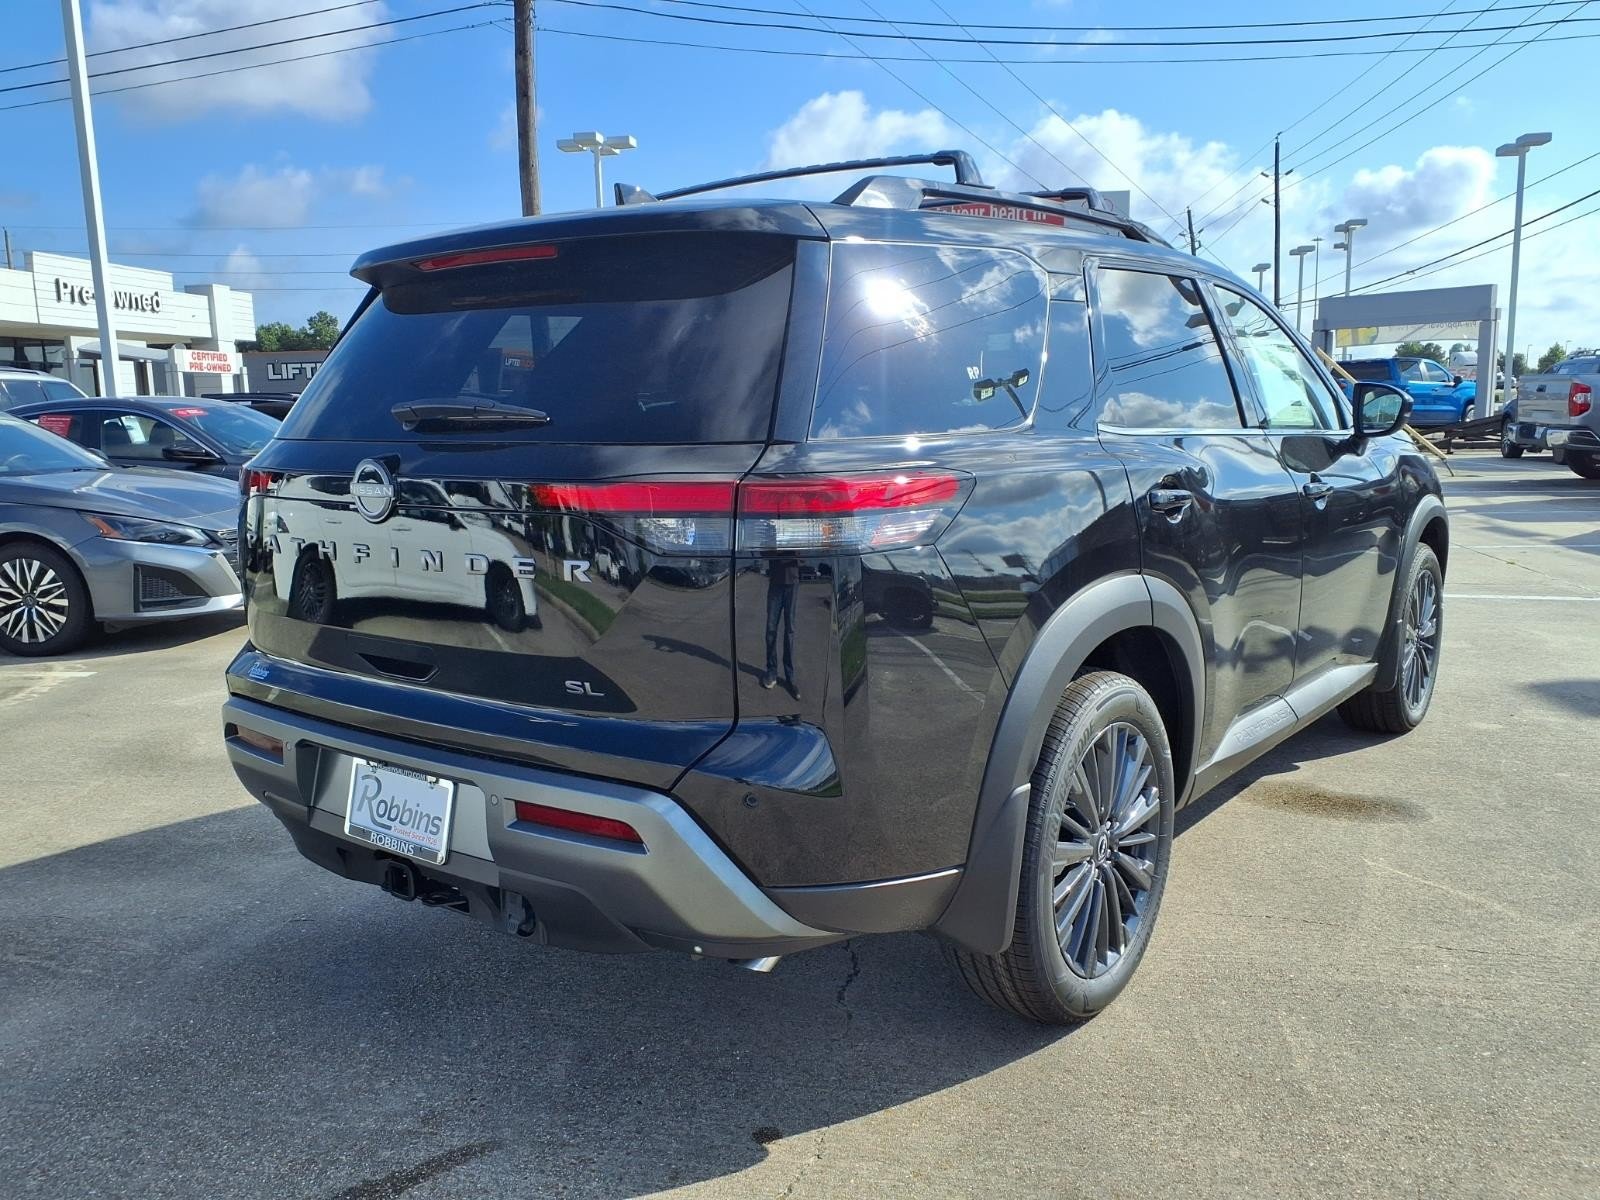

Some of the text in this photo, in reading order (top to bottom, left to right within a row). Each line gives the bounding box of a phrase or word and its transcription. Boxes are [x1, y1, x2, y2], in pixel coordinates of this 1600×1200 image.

[54, 277, 162, 314] Pre-wned
[189, 361, 232, 373] PRE-OWNED
[191, 351, 228, 362] CERTIFIED
[267, 362, 324, 381] LIFT
[246, 532, 593, 583] PATHFINDER
[564, 680, 605, 697] SL
[357, 774, 442, 836] Robbins
[370, 832, 415, 855] ROBBINS
